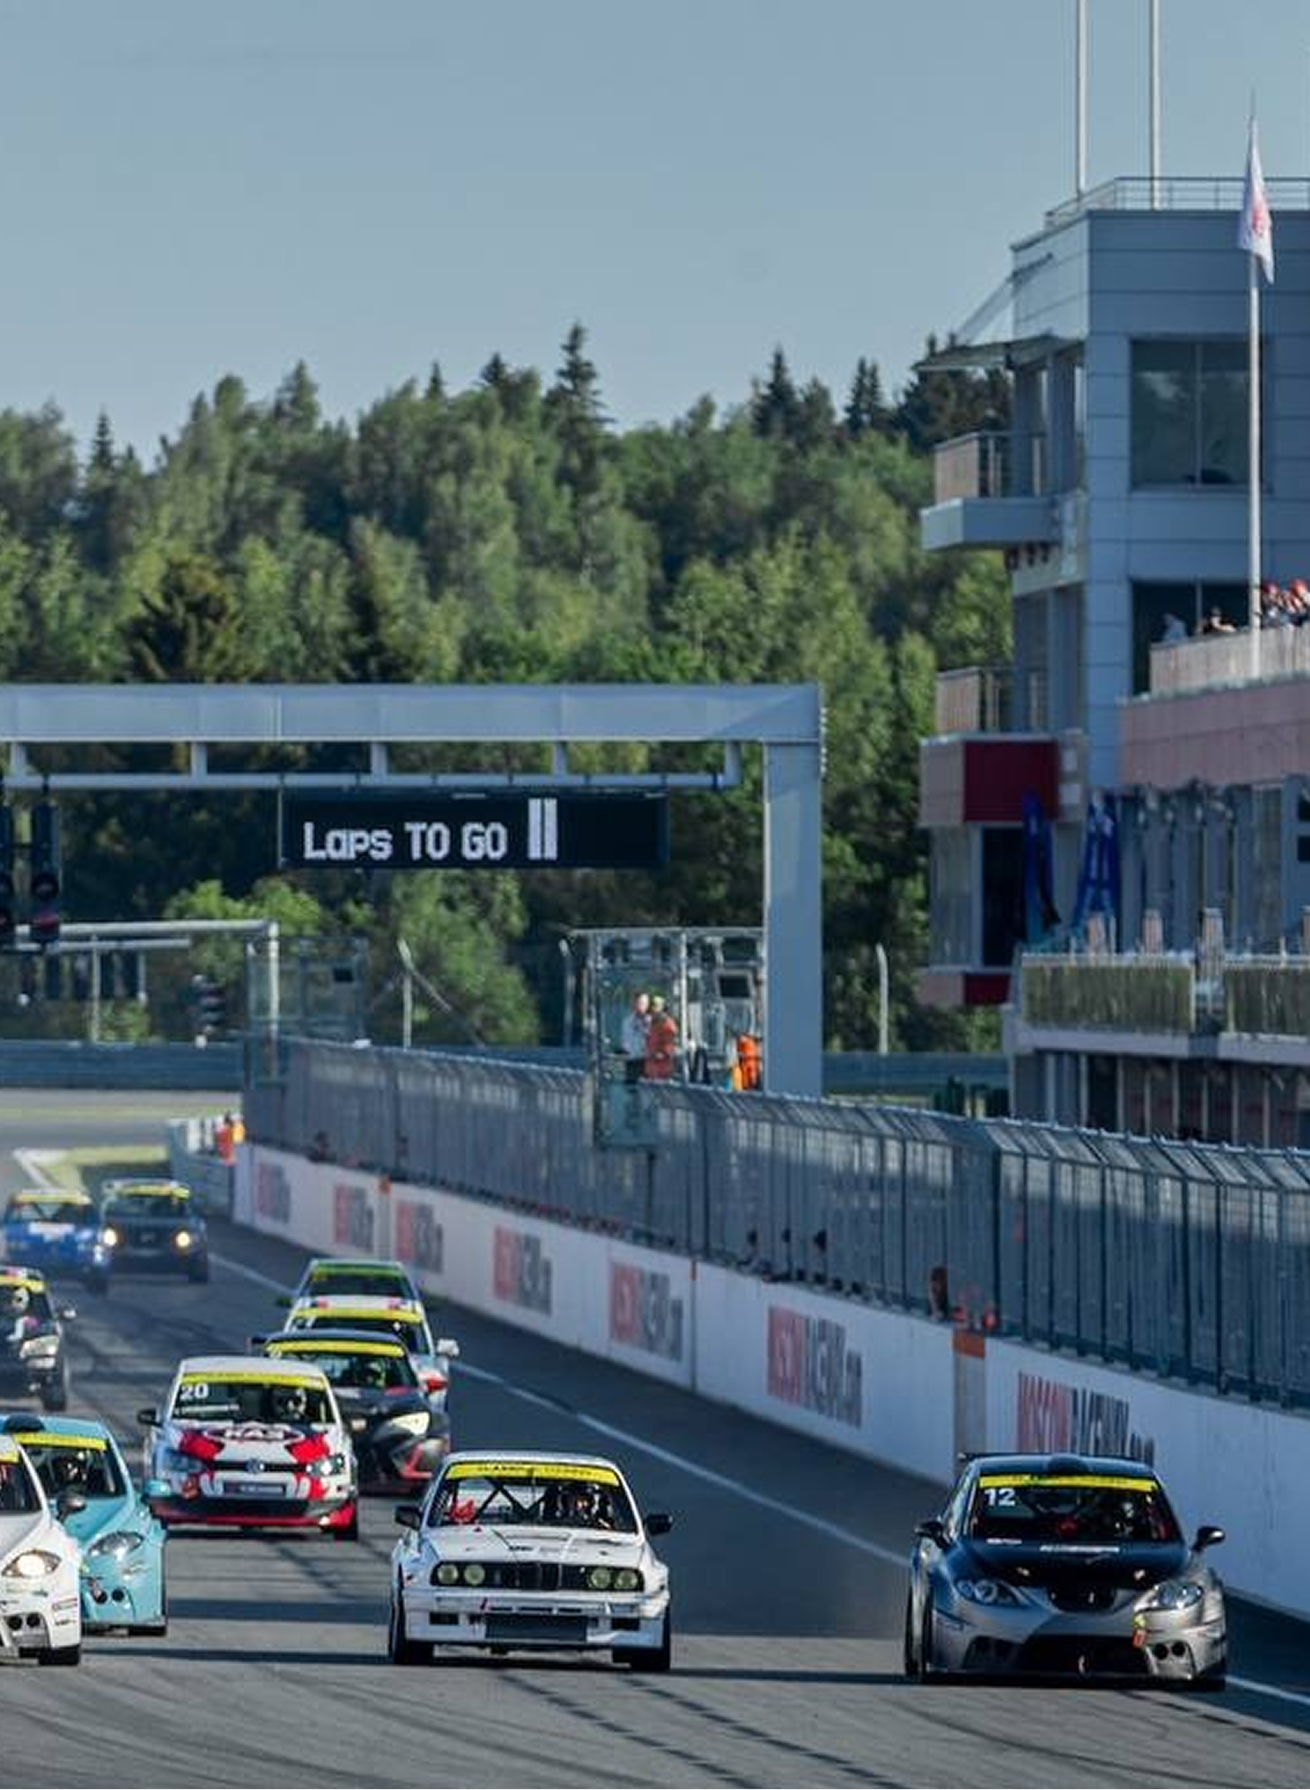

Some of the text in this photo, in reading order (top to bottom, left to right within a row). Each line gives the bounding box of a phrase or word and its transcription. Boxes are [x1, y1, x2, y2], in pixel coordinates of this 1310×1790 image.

[303, 822, 392, 860] Laps
[404, 822, 451, 860] TO
[460, 822, 508, 860] GO
[180, 1383, 208, 1401] 20
[984, 1488, 1016, 1507] 12
